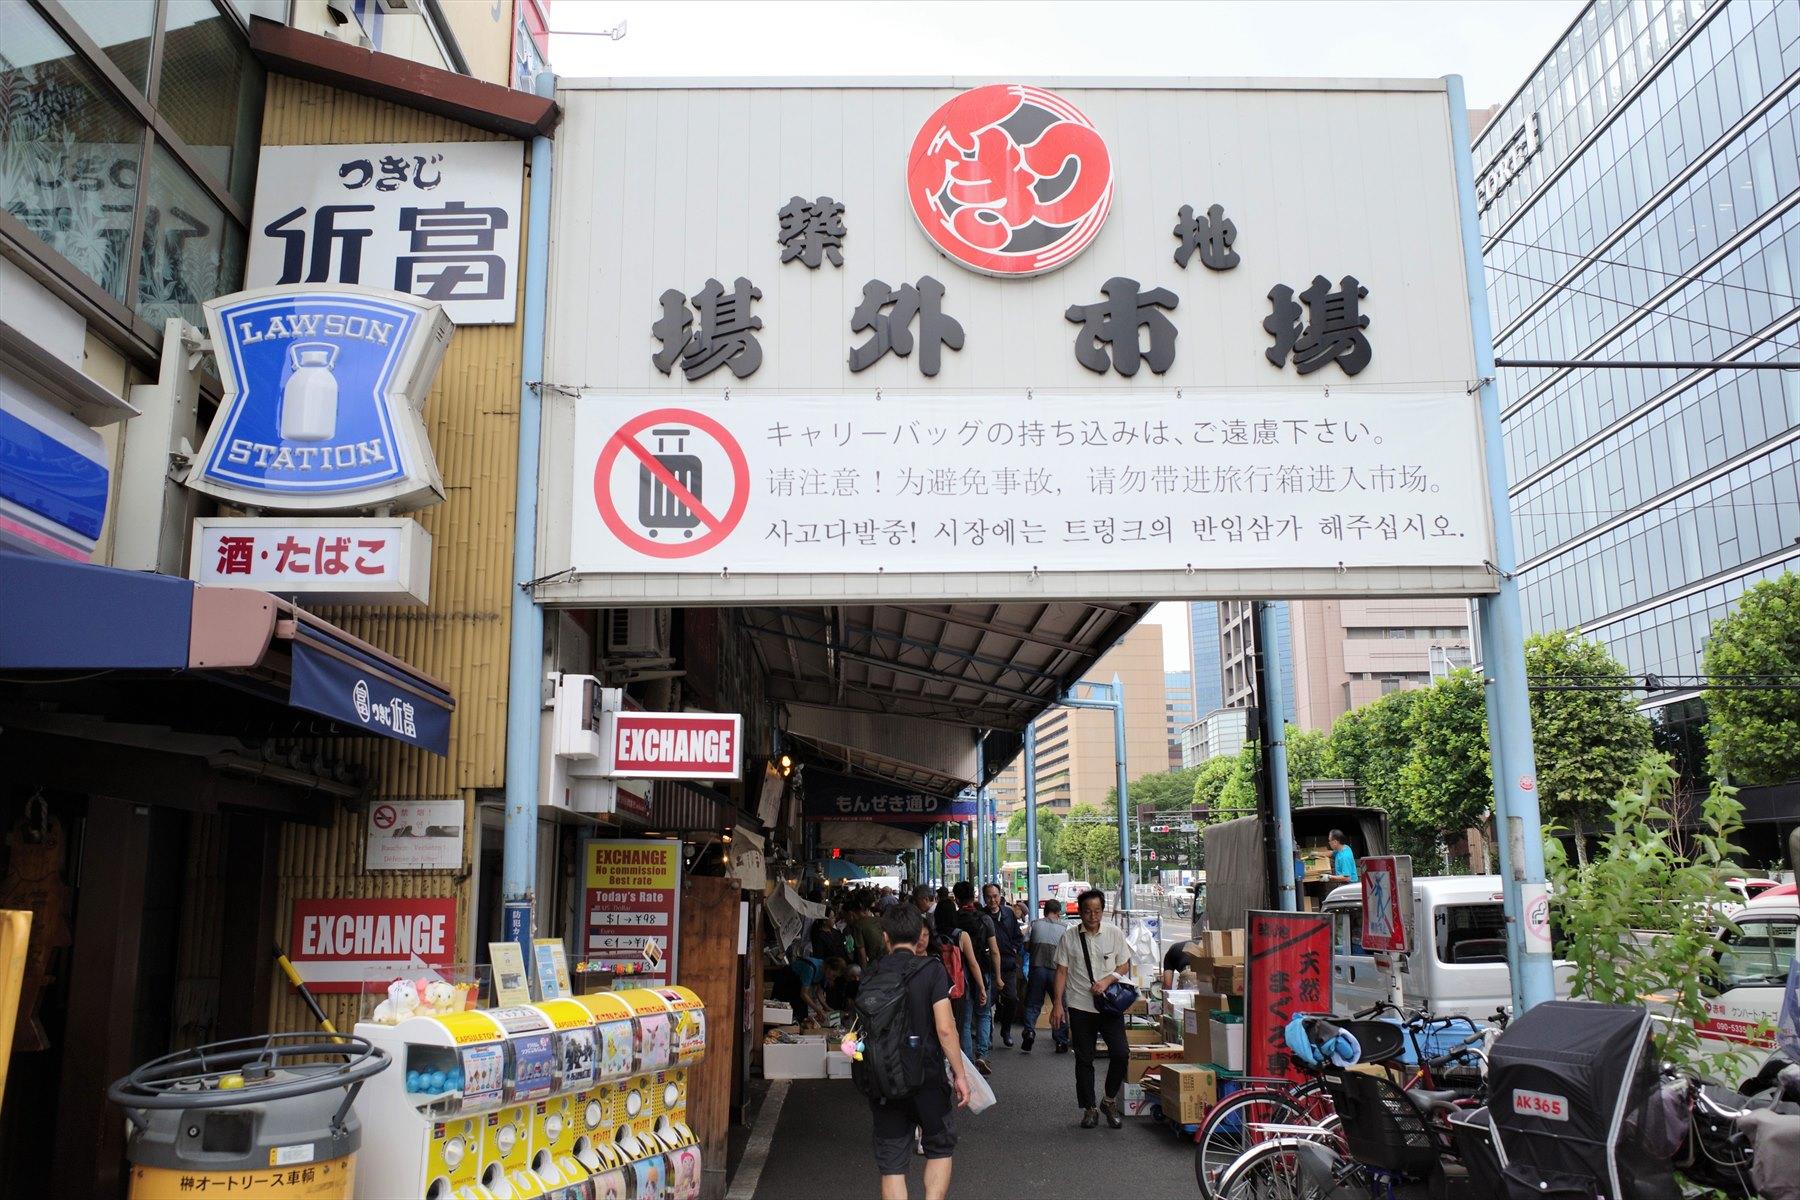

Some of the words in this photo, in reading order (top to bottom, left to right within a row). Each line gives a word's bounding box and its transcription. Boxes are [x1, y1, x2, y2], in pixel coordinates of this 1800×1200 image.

[338, 154, 443, 192] つきじ
[241, 314, 394, 345] LAWSON
[766, 418, 1385, 448] キャリーバッグの持ち込みは、ご遠慮下さい。
[228, 438, 385, 470] STATION
[765, 518, 916, 547] 사고다발중!
[933, 517, 1047, 547] 시장에는
[1063, 516, 1173, 545] 트렁크의
[1192, 514, 1303, 543] 반입삼가
[1319, 513, 1465, 541] 해주십시오.
[618, 728, 731, 763] EXCHANGE
[836, 794, 938, 813] もんぜき通り
[596, 850, 667, 865] EXCHANGE
[596, 866, 607, 875] No
[610, 866, 666, 875] commission
[609, 876, 630, 885] Best
[632, 876, 652, 885] rate
[596, 891, 636, 903] Today's
[639, 891, 664, 902] Rate
[301, 915, 446, 956] EXCHANGE
